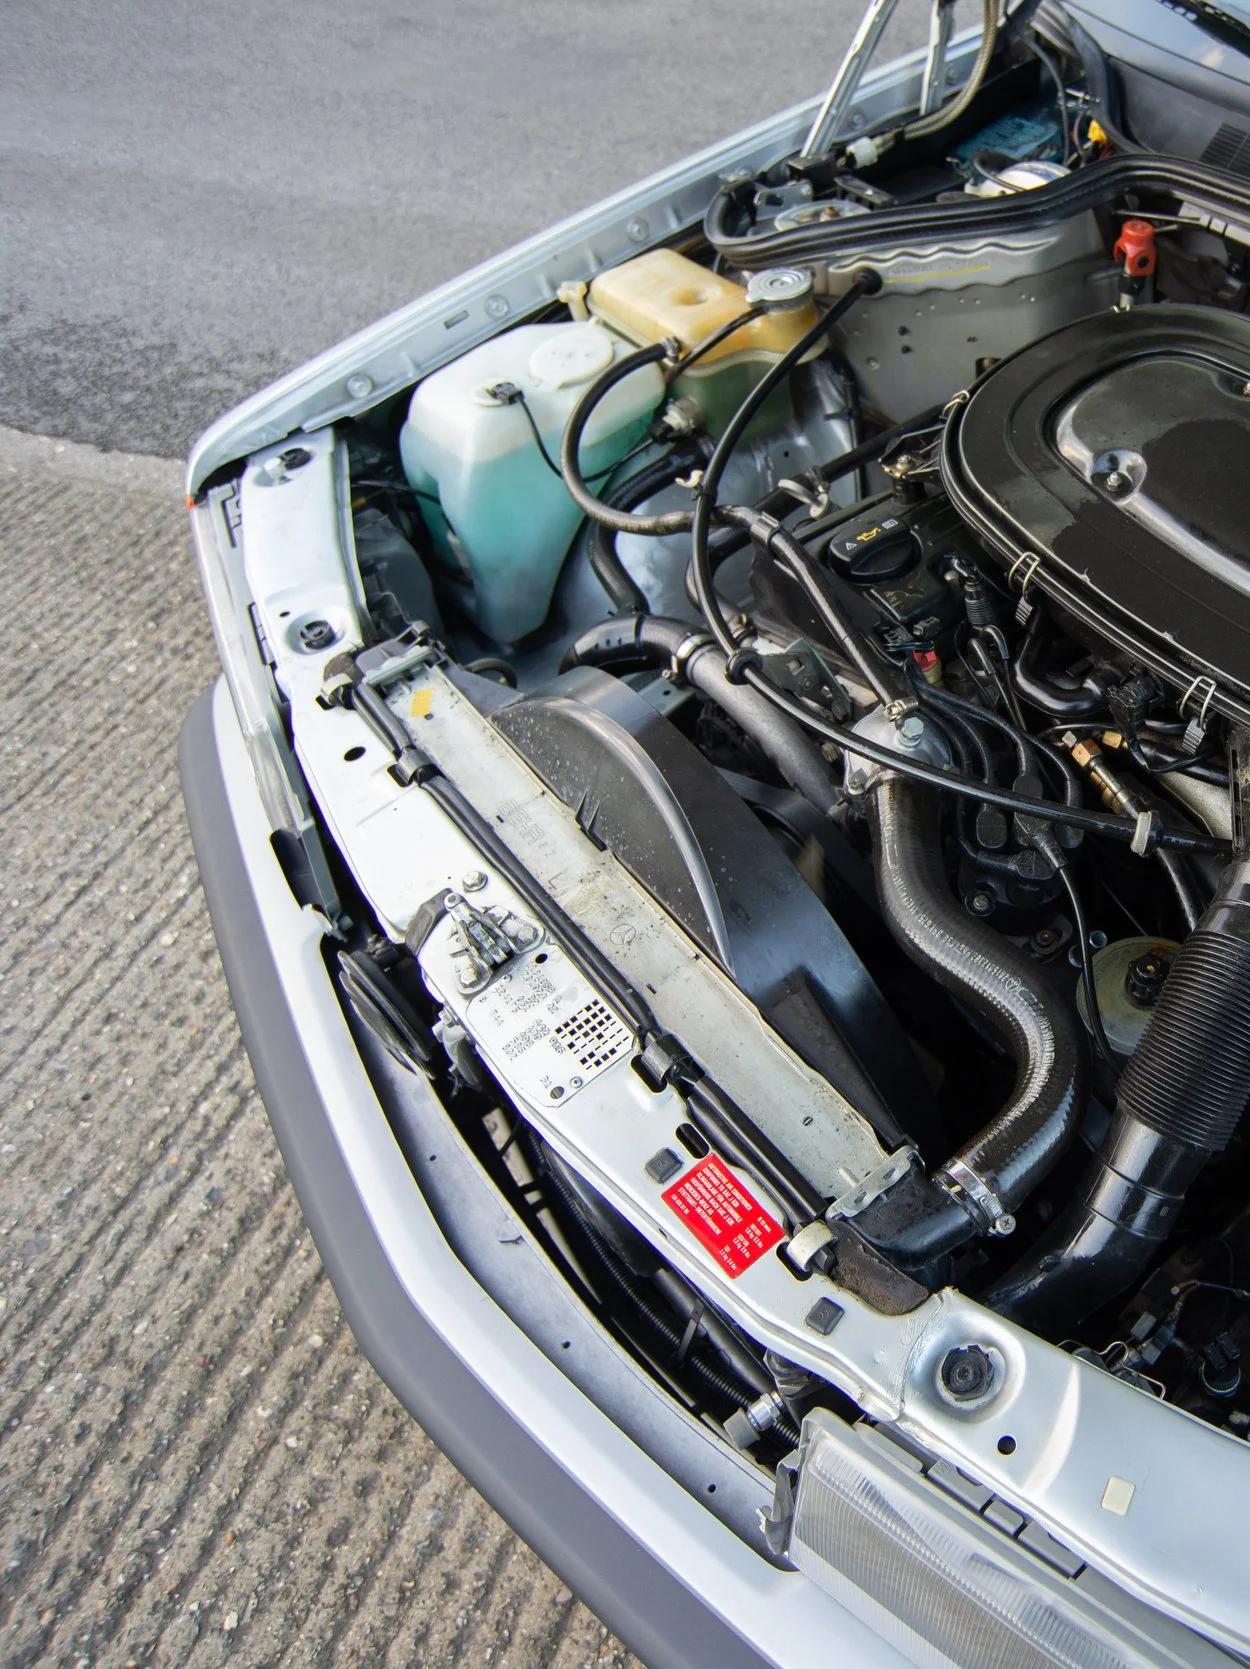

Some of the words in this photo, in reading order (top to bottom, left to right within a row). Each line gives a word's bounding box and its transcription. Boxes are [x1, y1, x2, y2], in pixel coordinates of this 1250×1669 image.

[682, 1181, 710, 1210] MERCEDES-BENZ
[688, 1175, 713, 1200] AUSFÜHRUNG
[707, 1197, 720, 1209] NACH
[716, 1206, 726, 1216] SAE
[695, 1170, 719, 1196] KLIMAANLAGE
[701, 1165, 721, 1187] CONFORMS
[721, 1188, 732, 1199] SAE
[707, 1161, 729, 1185] AUTOMOTIVE
[724, 1181, 734, 1191] AIR
[730, 1187, 753, 1212] CONDITIONER
[714, 1192, 727, 1203] FÜR
[720, 1200, 743, 1224] AUTOMOBILE
